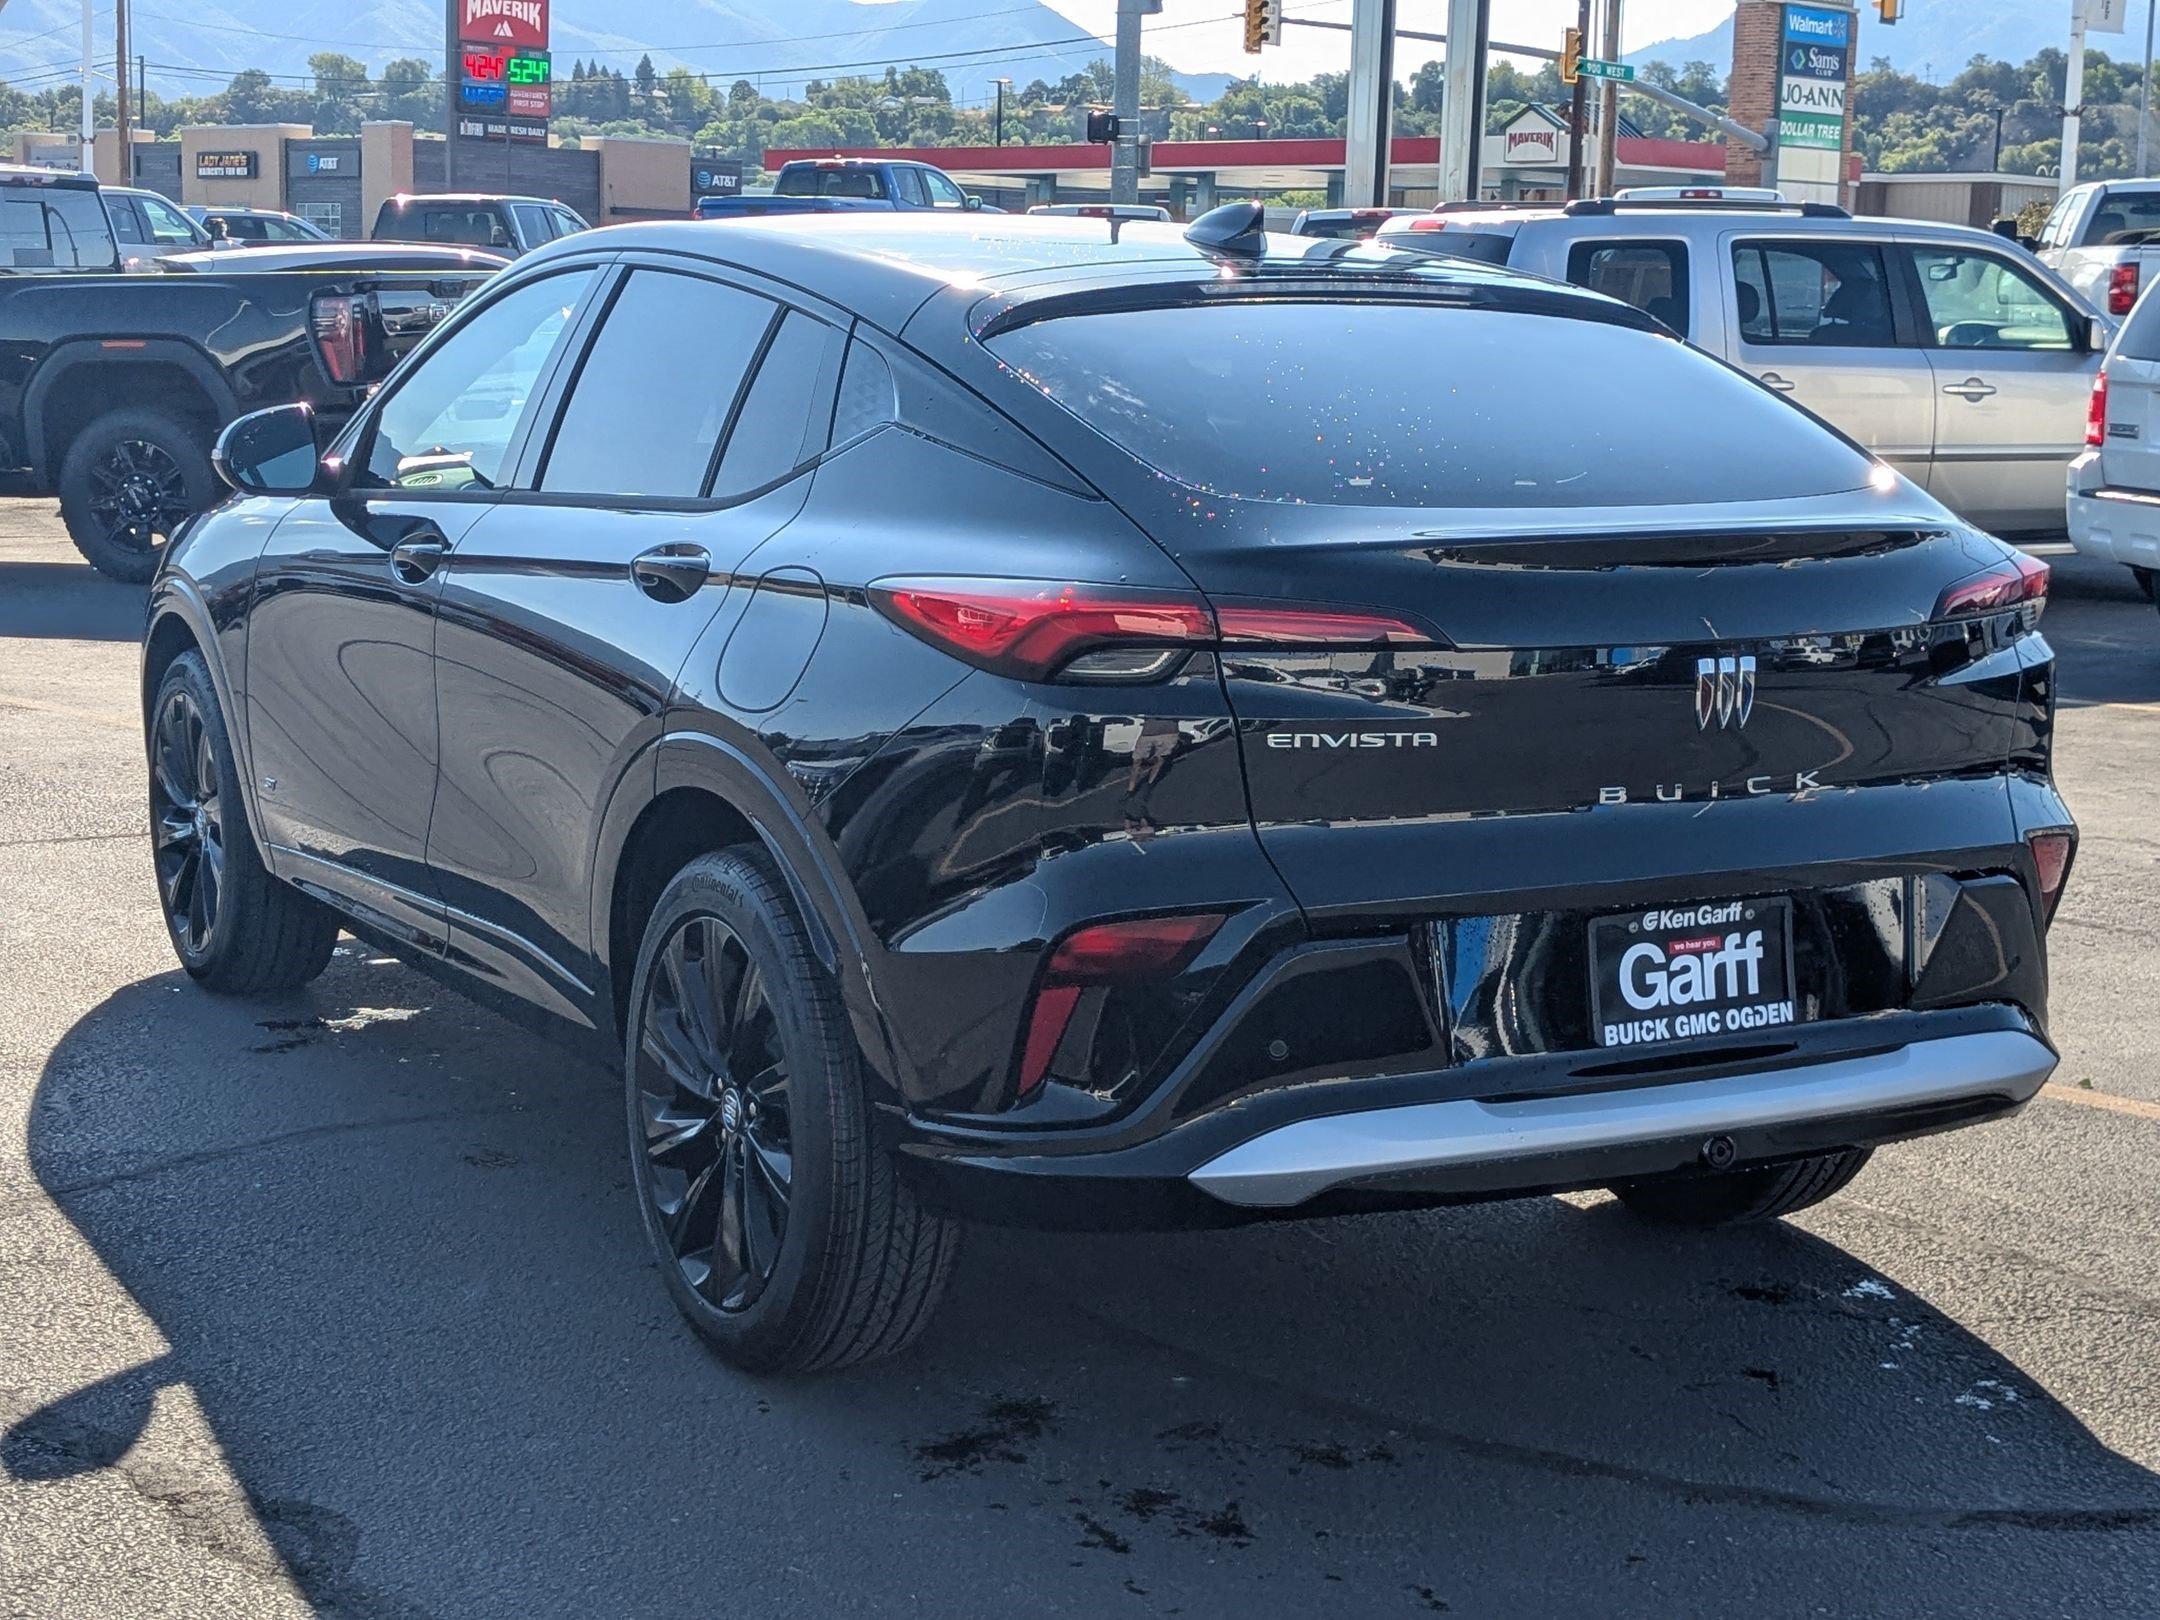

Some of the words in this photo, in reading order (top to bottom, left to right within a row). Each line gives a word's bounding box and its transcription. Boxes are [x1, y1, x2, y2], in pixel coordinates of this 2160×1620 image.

[466, 0, 541, 32] MAVERIK
[1789, 14, 1833, 36] Walmart
[1587, 62, 1602, 75] 900
[1606, 65, 1625, 77] WEST
[1808, 47, 1839, 70] Sam's
[1782, 83, 1845, 109] JO-ANN
[1780, 121, 1815, 137] DOLLAR
[1817, 125, 1841, 140] TREE
[1508, 132, 1555, 154] MAVERIK
[199, 155, 220, 167] LADY
[319, 157, 339, 169] AT&T
[712, 174, 738, 187] AT&T
[1267, 732, 1438, 749] ENVISTA
[1599, 771, 1820, 804] BUICK
[1659, 908, 1695, 930] Ken
[1697, 901, 1743, 925] Garff
[1673, 943, 1685, 951] we
[1685, 941, 1702, 949] hear
[1702, 939, 1716, 950] you
[1619, 930, 1764, 1010] Garff
[1604, 1018, 1671, 1047] BUICK
[1674, 1011, 1721, 1039] GMC
[1726, 1001, 1794, 1030] OGDEN
